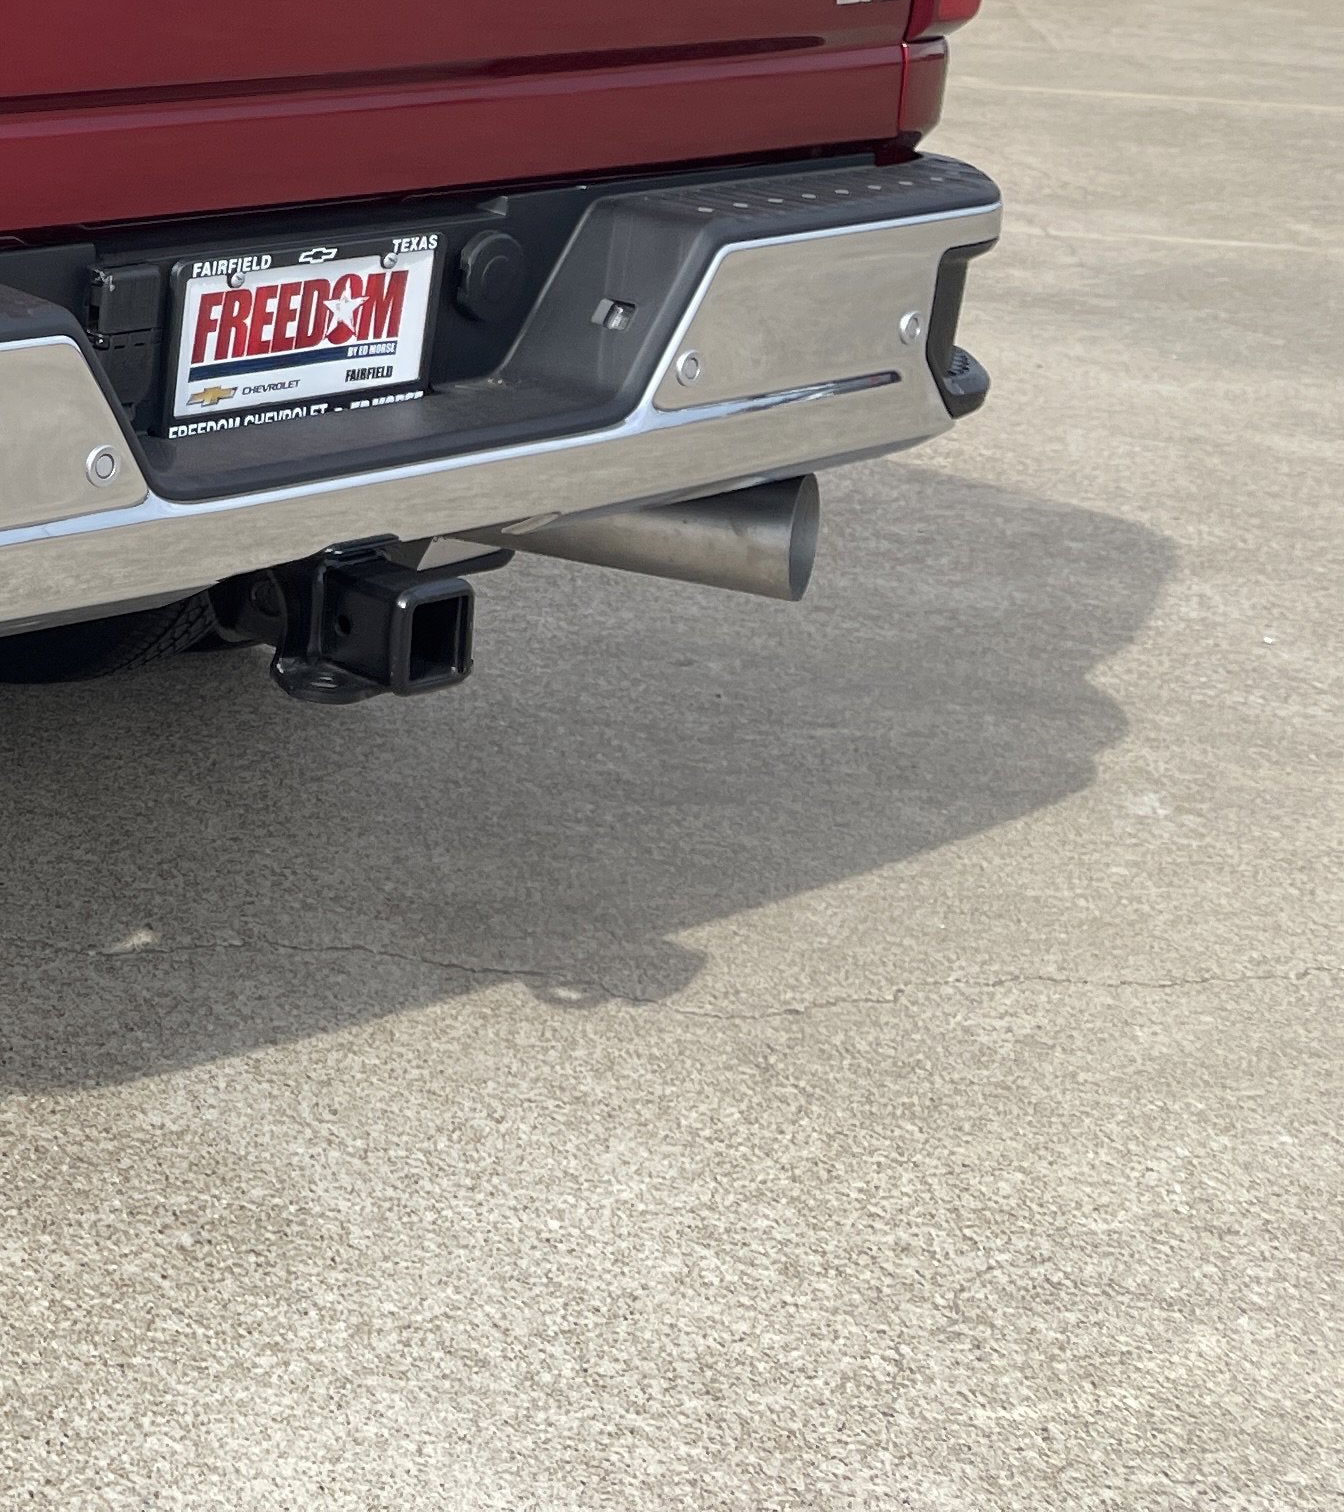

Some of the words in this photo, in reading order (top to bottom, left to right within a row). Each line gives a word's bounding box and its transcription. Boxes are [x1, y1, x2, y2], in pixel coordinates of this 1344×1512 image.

[192, 254, 272, 278] FAIRFIELD
[392, 234, 438, 253] TEXAS
[191, 270, 410, 365] FREEDOM
[242, 379, 300, 396] CHEVROLET
[345, 366, 393, 383] FAIRFIELD
